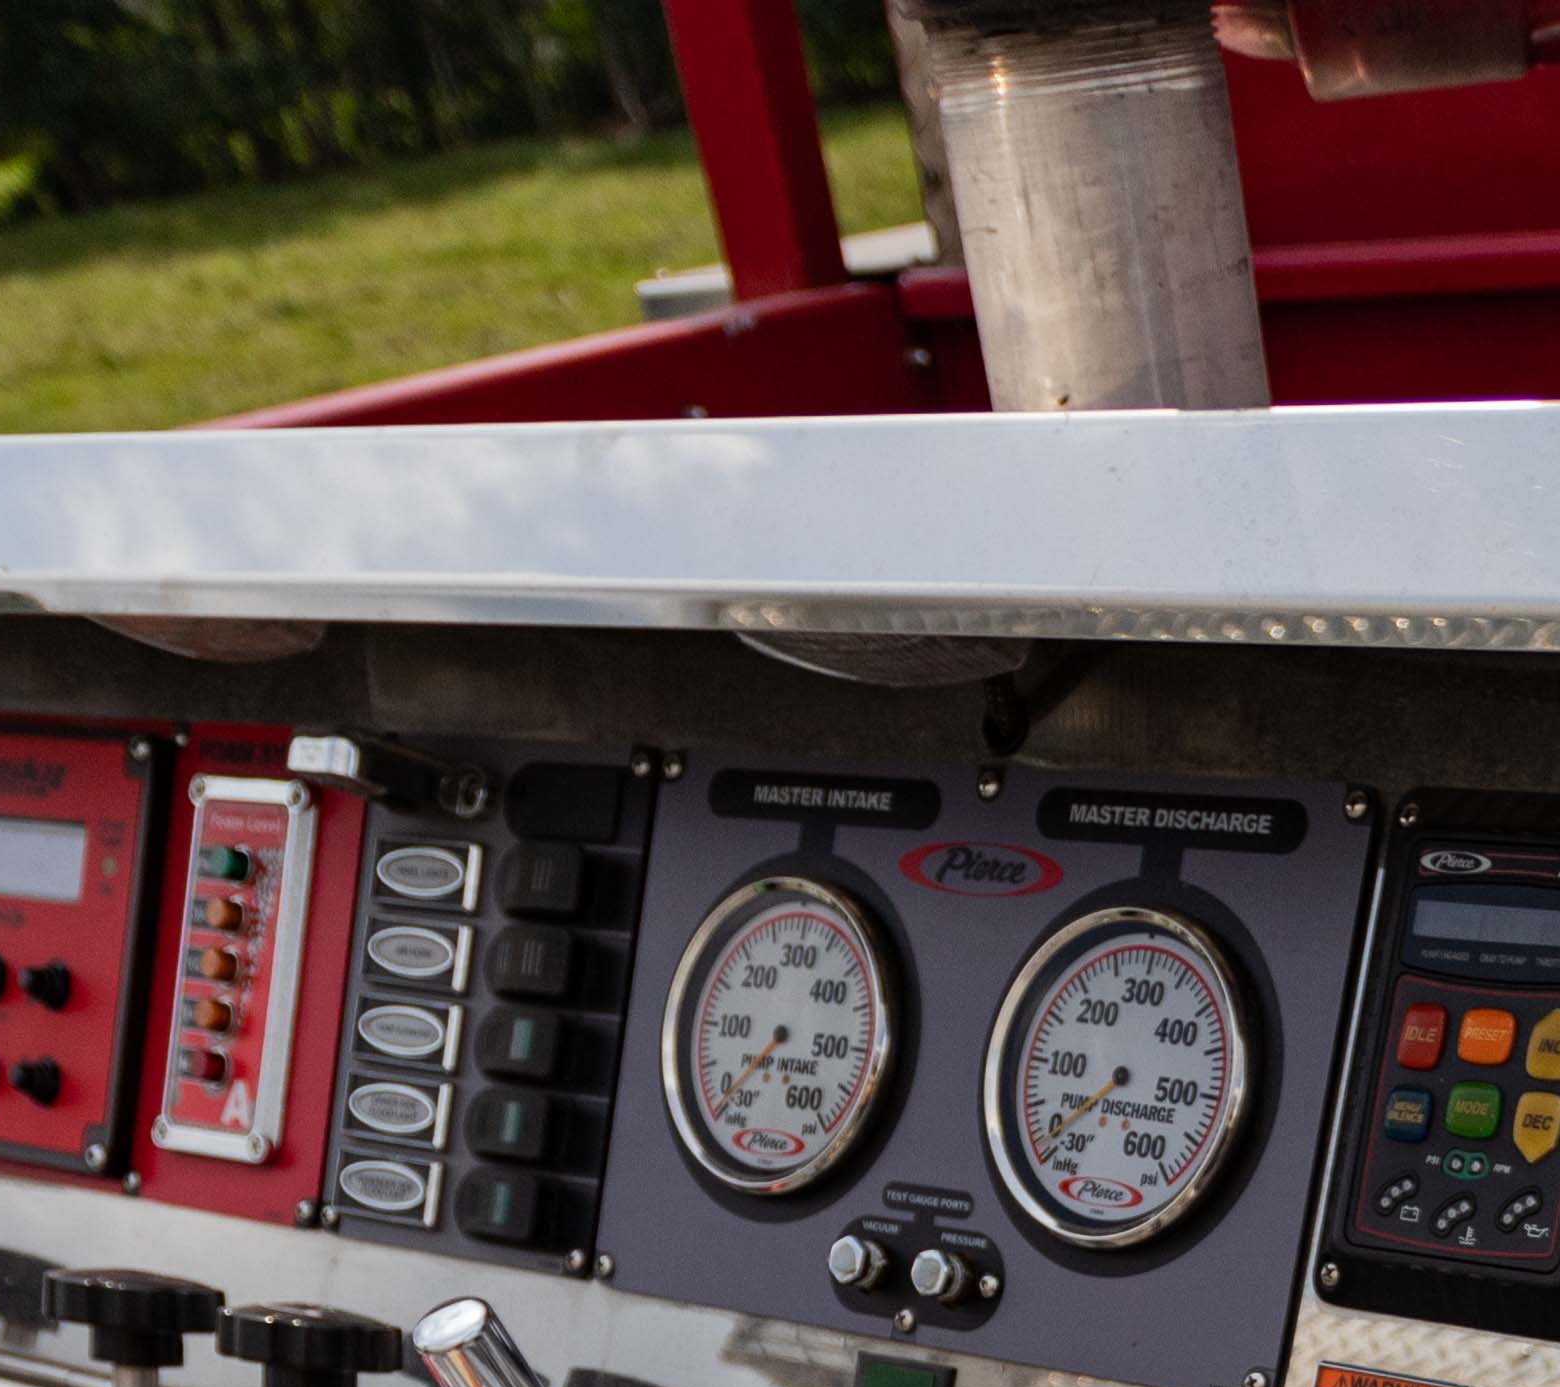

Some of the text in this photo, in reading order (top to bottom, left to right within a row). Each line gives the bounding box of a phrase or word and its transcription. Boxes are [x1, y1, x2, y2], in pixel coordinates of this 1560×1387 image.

[754, 785, 892, 811] MASTER INTAKE
[1069, 805, 1273, 835] MASTER DISCHARGE
[935, 846, 1026, 886] Pierce
[1122, 977, 1164, 1006] 300
[1076, 998, 1118, 1027] 200
[1154, 1018, 1197, 1047] 400
[1049, 1050, 1086, 1079] 100
[1154, 1076, 1198, 1106] 500
[1523, 1112, 1554, 1132] DEC
[1122, 1133, 1166, 1160] 600
